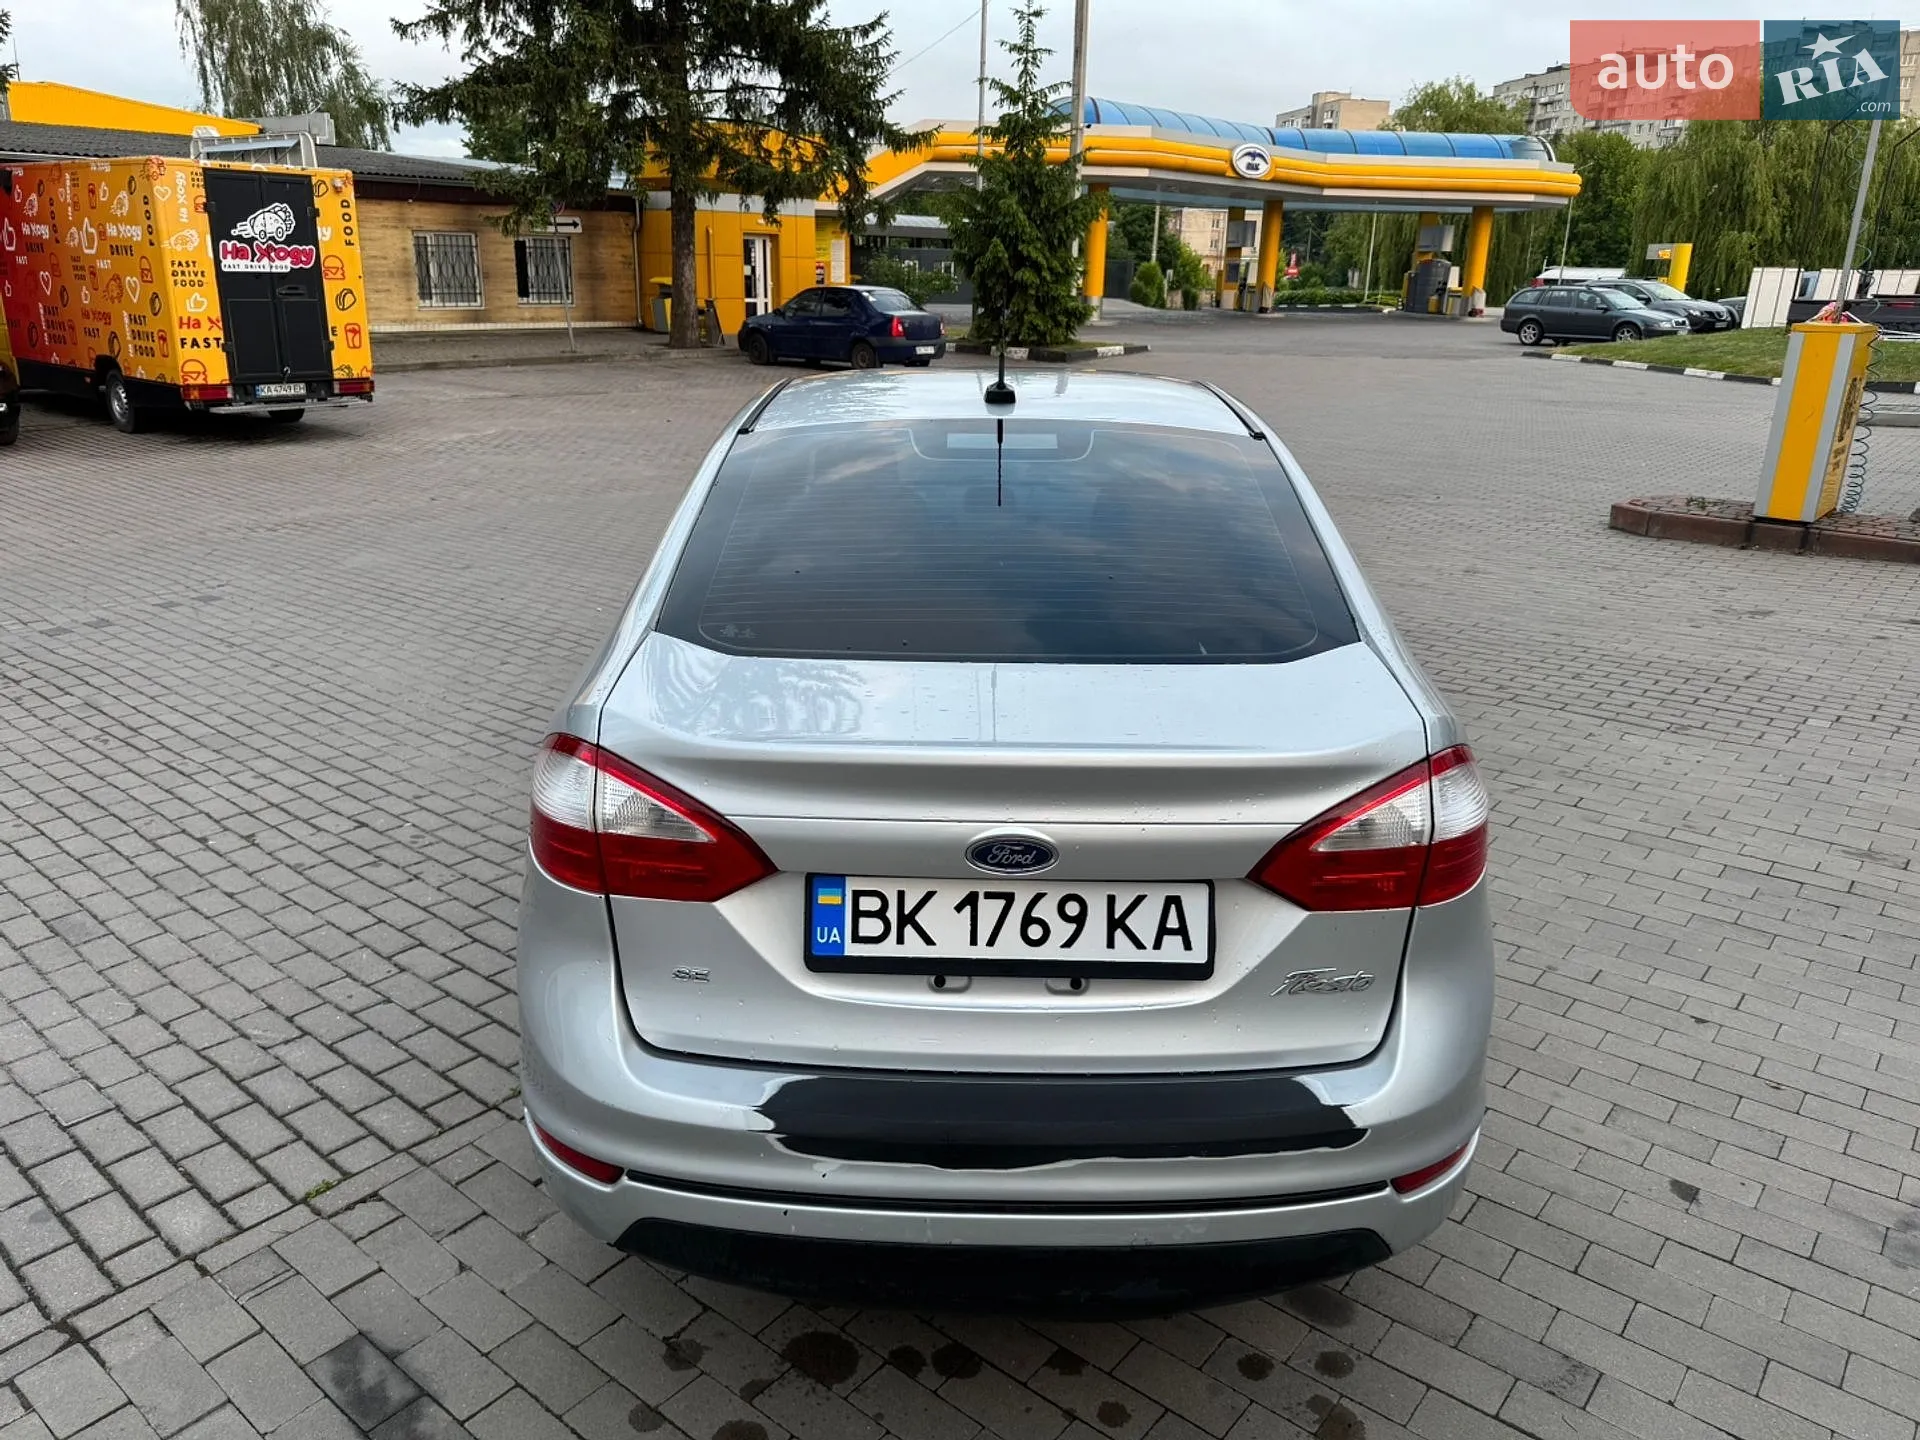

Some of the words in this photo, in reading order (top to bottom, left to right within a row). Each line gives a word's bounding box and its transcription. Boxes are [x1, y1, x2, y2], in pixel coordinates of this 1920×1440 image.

[142, 195, 155, 247] FOOD
[341, 199, 355, 246] FOOD
[109, 244, 134, 257] DRIVE
[96, 259, 111, 269] FAST
[171, 260, 198, 268] FAST
[171, 270, 206, 278] DRIVE
[129, 314, 147, 327] FAST
[131, 329, 156, 343] DRIVE
[180, 337, 222, 349] FAST
[986, 843, 1037, 867] Ford
[816, 927, 841, 944] UA
[851, 889, 938, 947] BK
[953, 890, 1089, 950] 1769
[1105, 893, 1194, 952] KA
[1269, 967, 1375, 997] Fiesta
